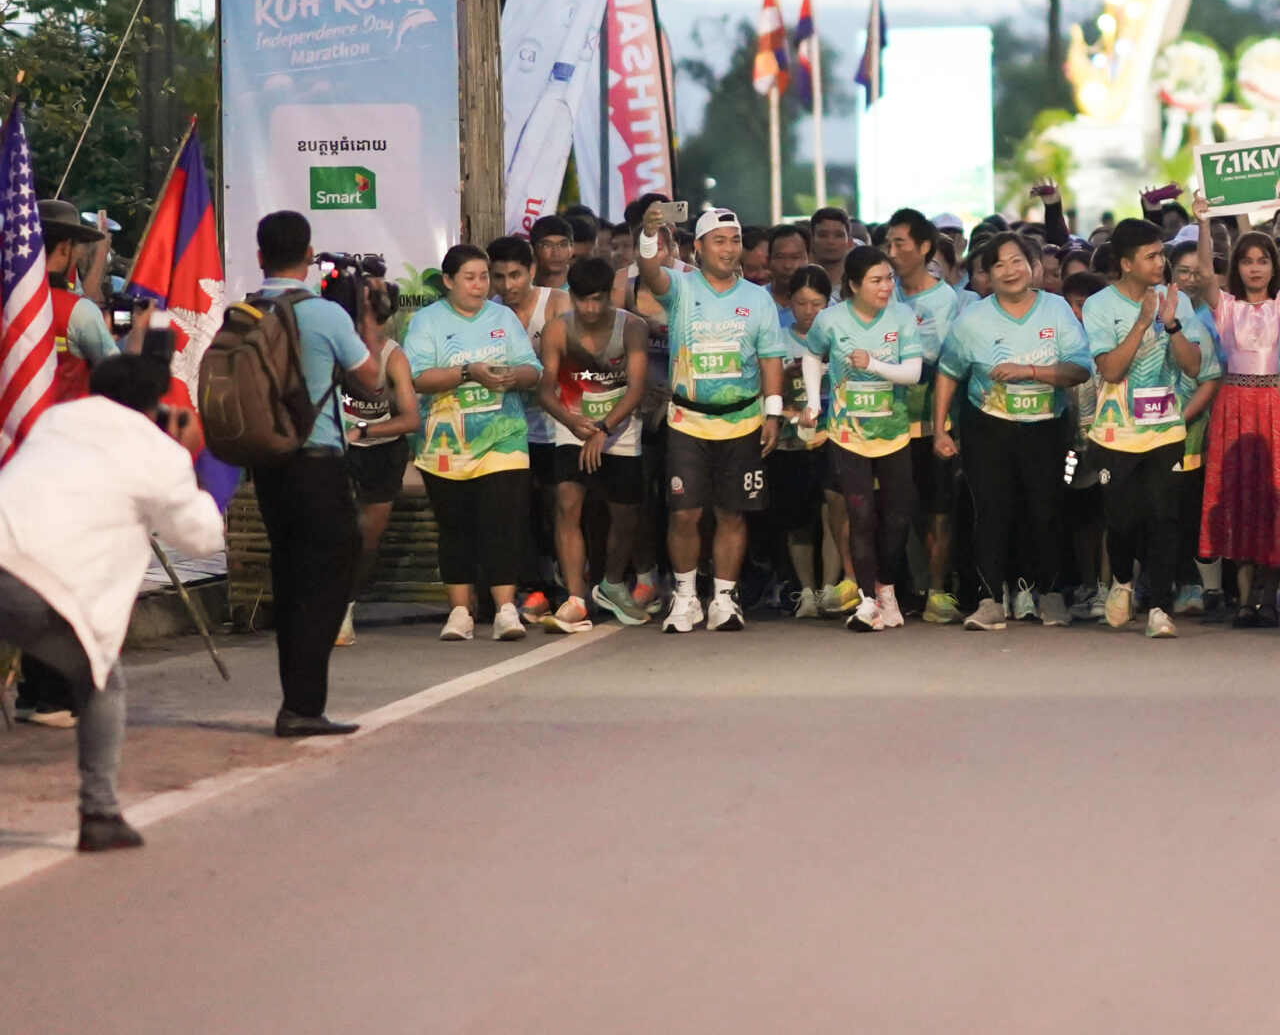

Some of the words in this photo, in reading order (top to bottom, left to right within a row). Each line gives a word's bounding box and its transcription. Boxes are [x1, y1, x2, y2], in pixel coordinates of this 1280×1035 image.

[255, 20, 358, 51] Independence
[363, 14, 394, 38] Day
[289, 41, 370, 66] Marathon
[316, 190, 363, 205] Smart
[464, 387, 490, 402] 313
[853, 393, 876, 406] 311
[588, 401, 613, 414] 016
[1012, 396, 1038, 409] 301
[1144, 402, 1162, 412] SAI
[743, 469, 764, 492] 85
